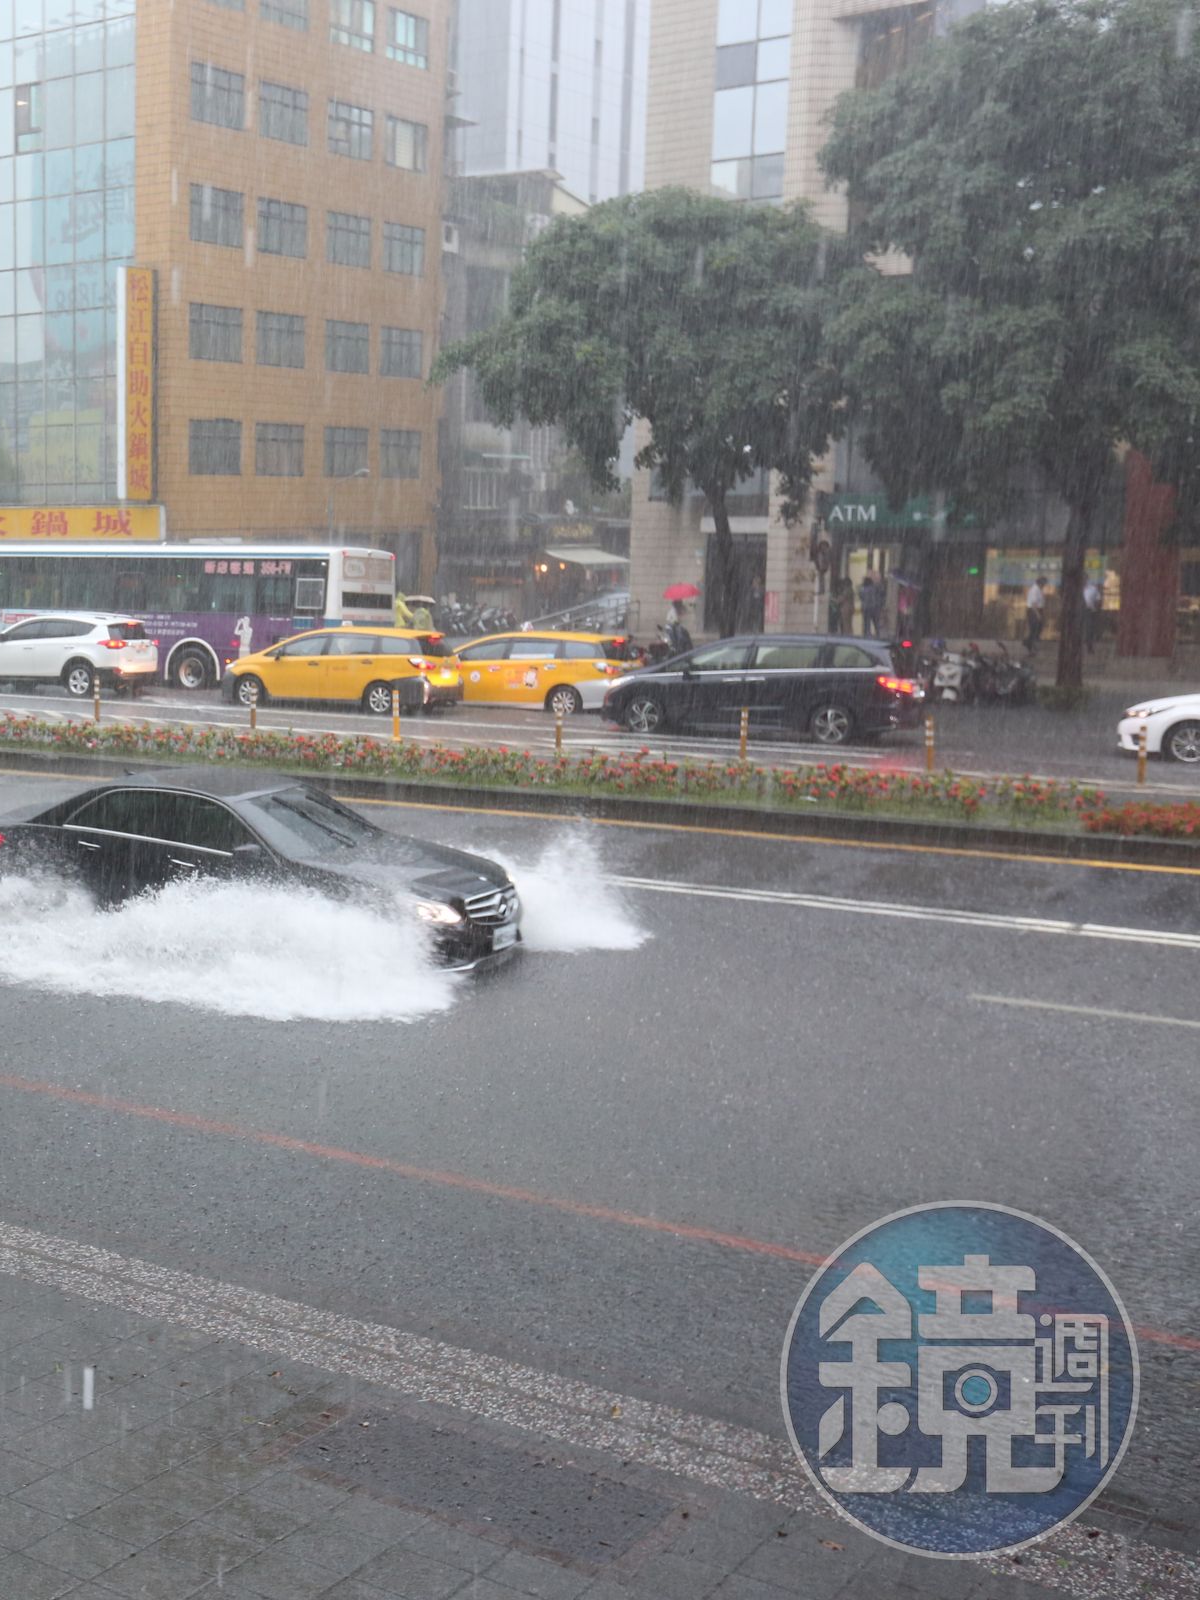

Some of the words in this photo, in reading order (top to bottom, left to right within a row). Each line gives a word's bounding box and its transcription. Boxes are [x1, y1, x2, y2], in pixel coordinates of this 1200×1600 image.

[128, 273, 149, 492] 松江自助火鍋城
[828, 504, 877, 522] ATM
